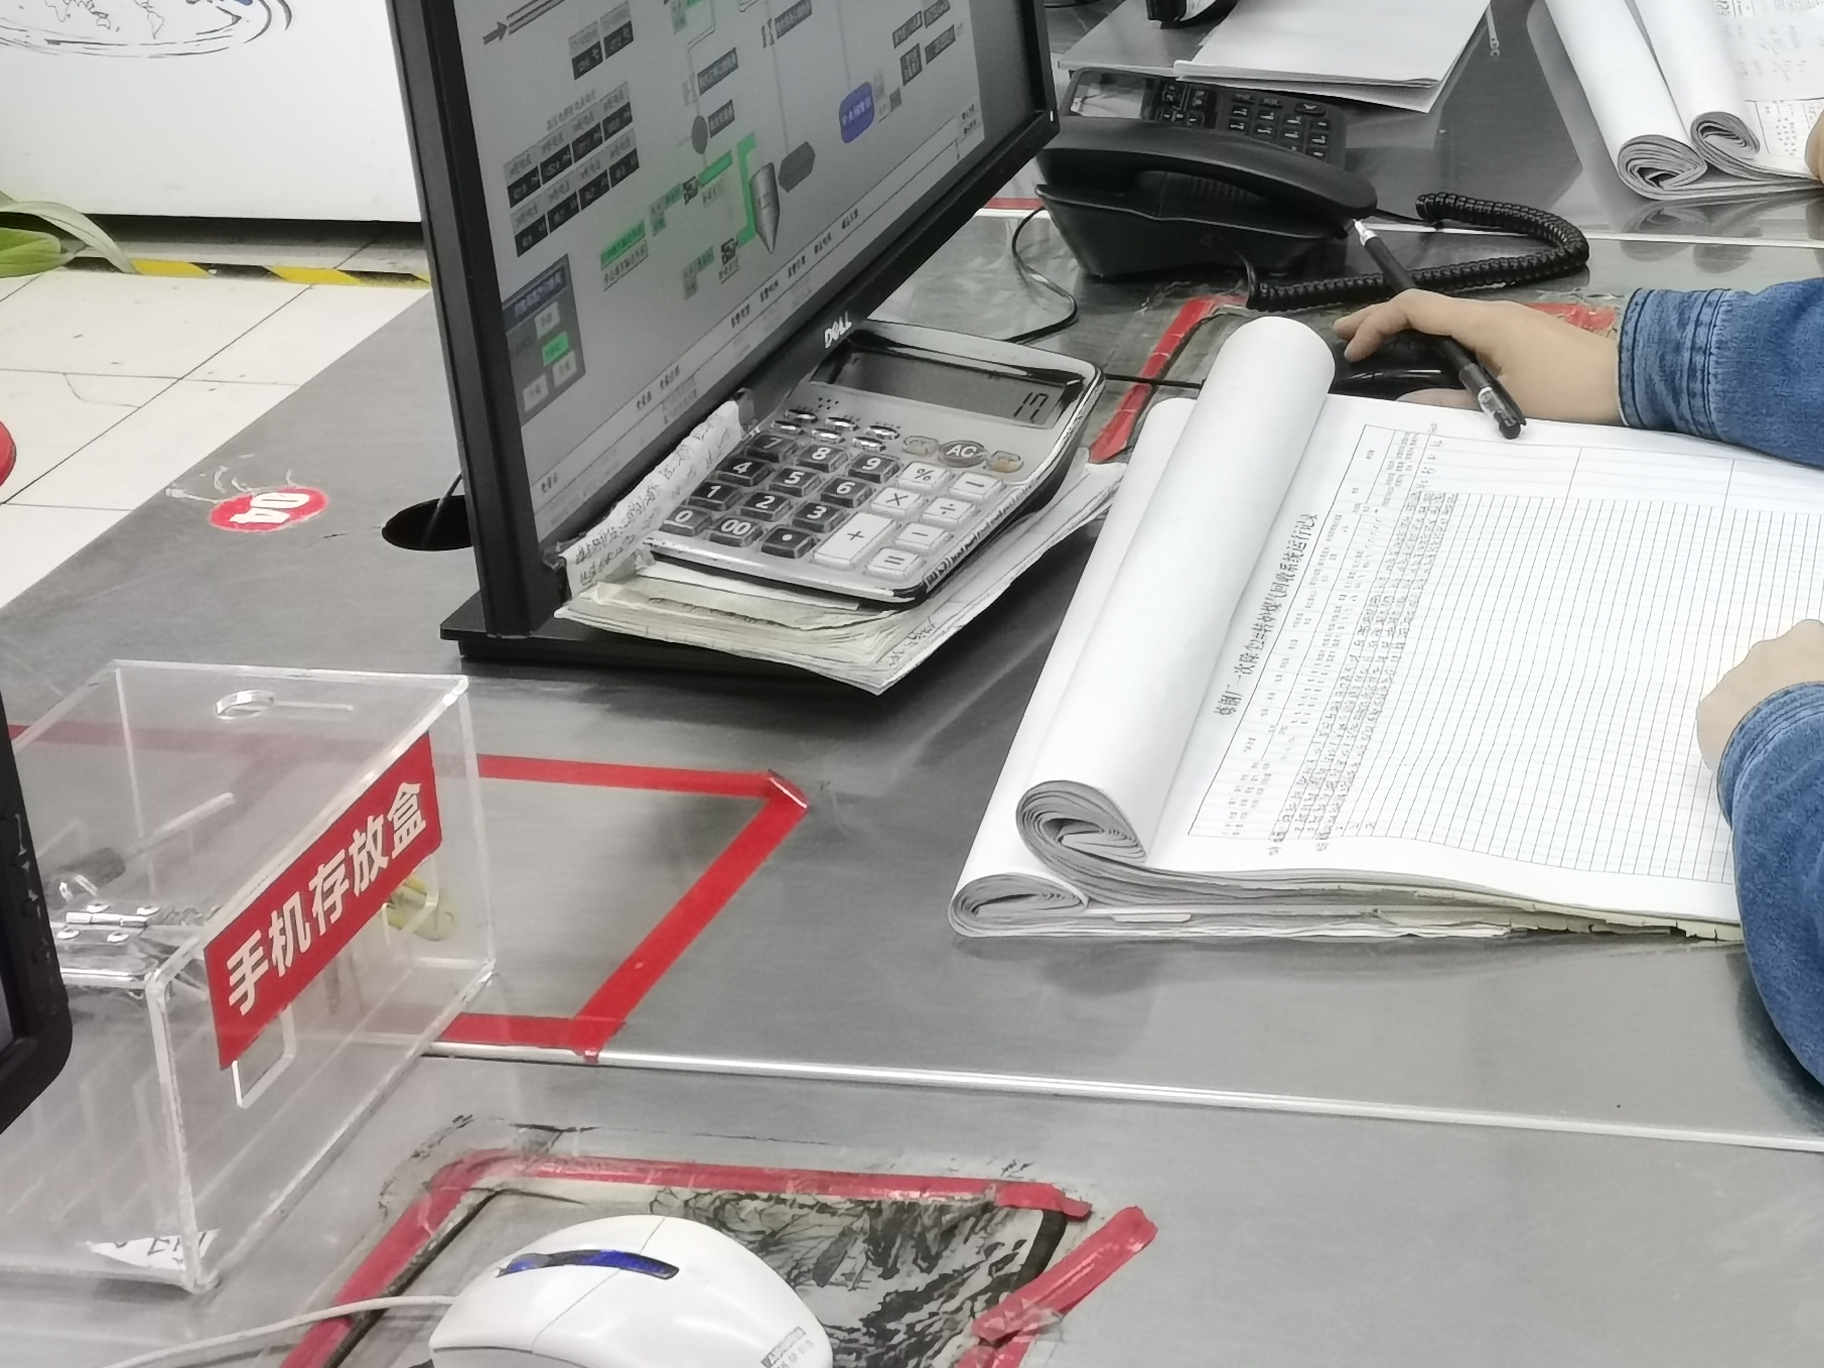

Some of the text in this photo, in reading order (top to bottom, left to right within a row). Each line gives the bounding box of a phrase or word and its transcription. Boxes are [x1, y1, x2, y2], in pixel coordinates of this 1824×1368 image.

[823, 315, 853, 349] DELL
[761, 436, 783, 451] 7
[812, 446, 832, 462] 8
[862, 456, 882, 472] 9
[944, 444, 977, 459] AC
[731, 460, 854, 496] 4 5 6
[229, 492, 311, 524] 04
[706, 483, 827, 520] 1 2 3
[674, 509, 753, 537] 0 00
[226, 782, 428, 1016] 手机存放盒
